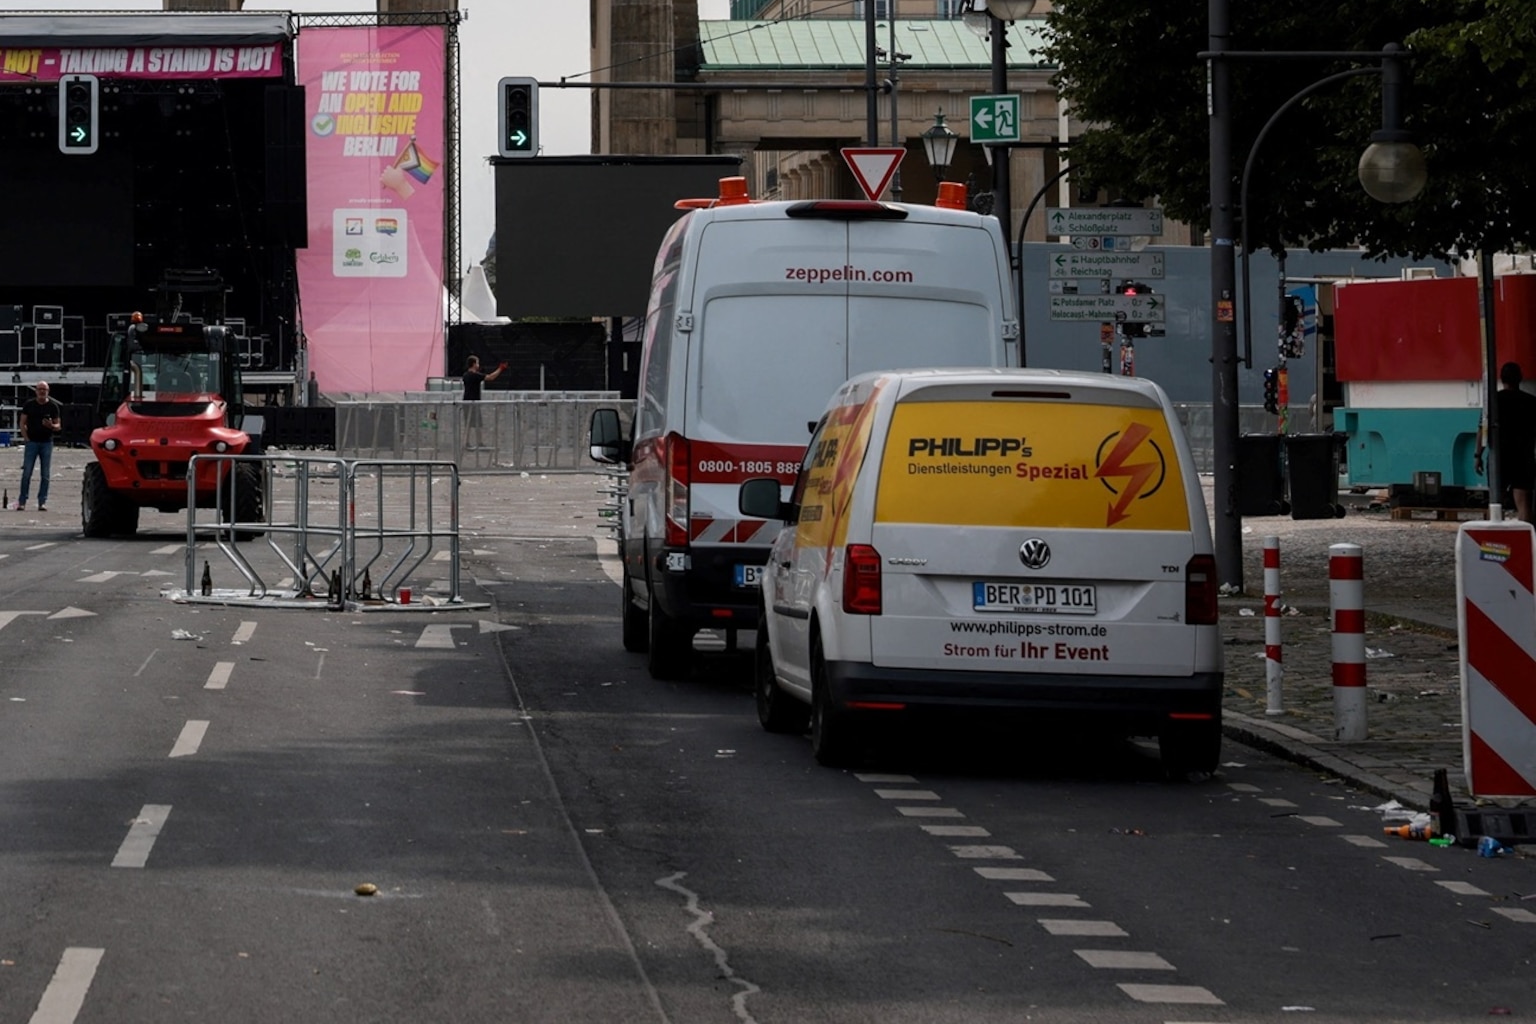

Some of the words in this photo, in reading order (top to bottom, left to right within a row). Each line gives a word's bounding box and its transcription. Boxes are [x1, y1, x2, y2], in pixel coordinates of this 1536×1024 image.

[4, 50, 42, 74] HOT
[60, 49, 129, 73] TAKING
[130, 49, 145, 72] A
[148, 48, 212, 72] STAND
[214, 47, 235, 71] IS
[237, 46, 276, 71] HOT
[321, 71, 348, 91] WE
[350, 71, 389, 91] VOTE
[389, 71, 421, 91] FOR
[318, 93, 343, 113] AN
[344, 93, 387, 113] OPEN
[388, 93, 423, 113] AND
[335, 114, 417, 135] INCLUSIVE
[343, 137, 399, 156] BERLIN
[1068, 211, 1132, 223] Alexanderplatz
[1068, 224, 1118, 233] Schloßplatz
[1080, 256, 1140, 265] Hauptbahnhof
[785, 265, 913, 284] zeppelin.com
[1070, 267, 1113, 277] Reichstag
[1061, 298, 1096, 307] Potsdamer
[1098, 298, 1115, 307] Platz
[908, 437, 1033, 458] PHILIPP's
[698, 460, 773, 474] 0800-1805
[907, 462, 1012, 477] Dienstleistungen
[1015, 462, 1089, 482] Spezial
[888, 557, 928, 567] CADDY
[1161, 565, 1180, 573] TDI
[987, 585, 1020, 604] BER
[1034, 587, 1056, 606] PD
[1064, 588, 1094, 607] 101
[950, 621, 1107, 637] www.philipps-strom.de
[944, 643, 990, 658] Strom
[994, 644, 1017, 659] für
[1021, 642, 1049, 659] Ihr
[1054, 643, 1109, 661] Event
